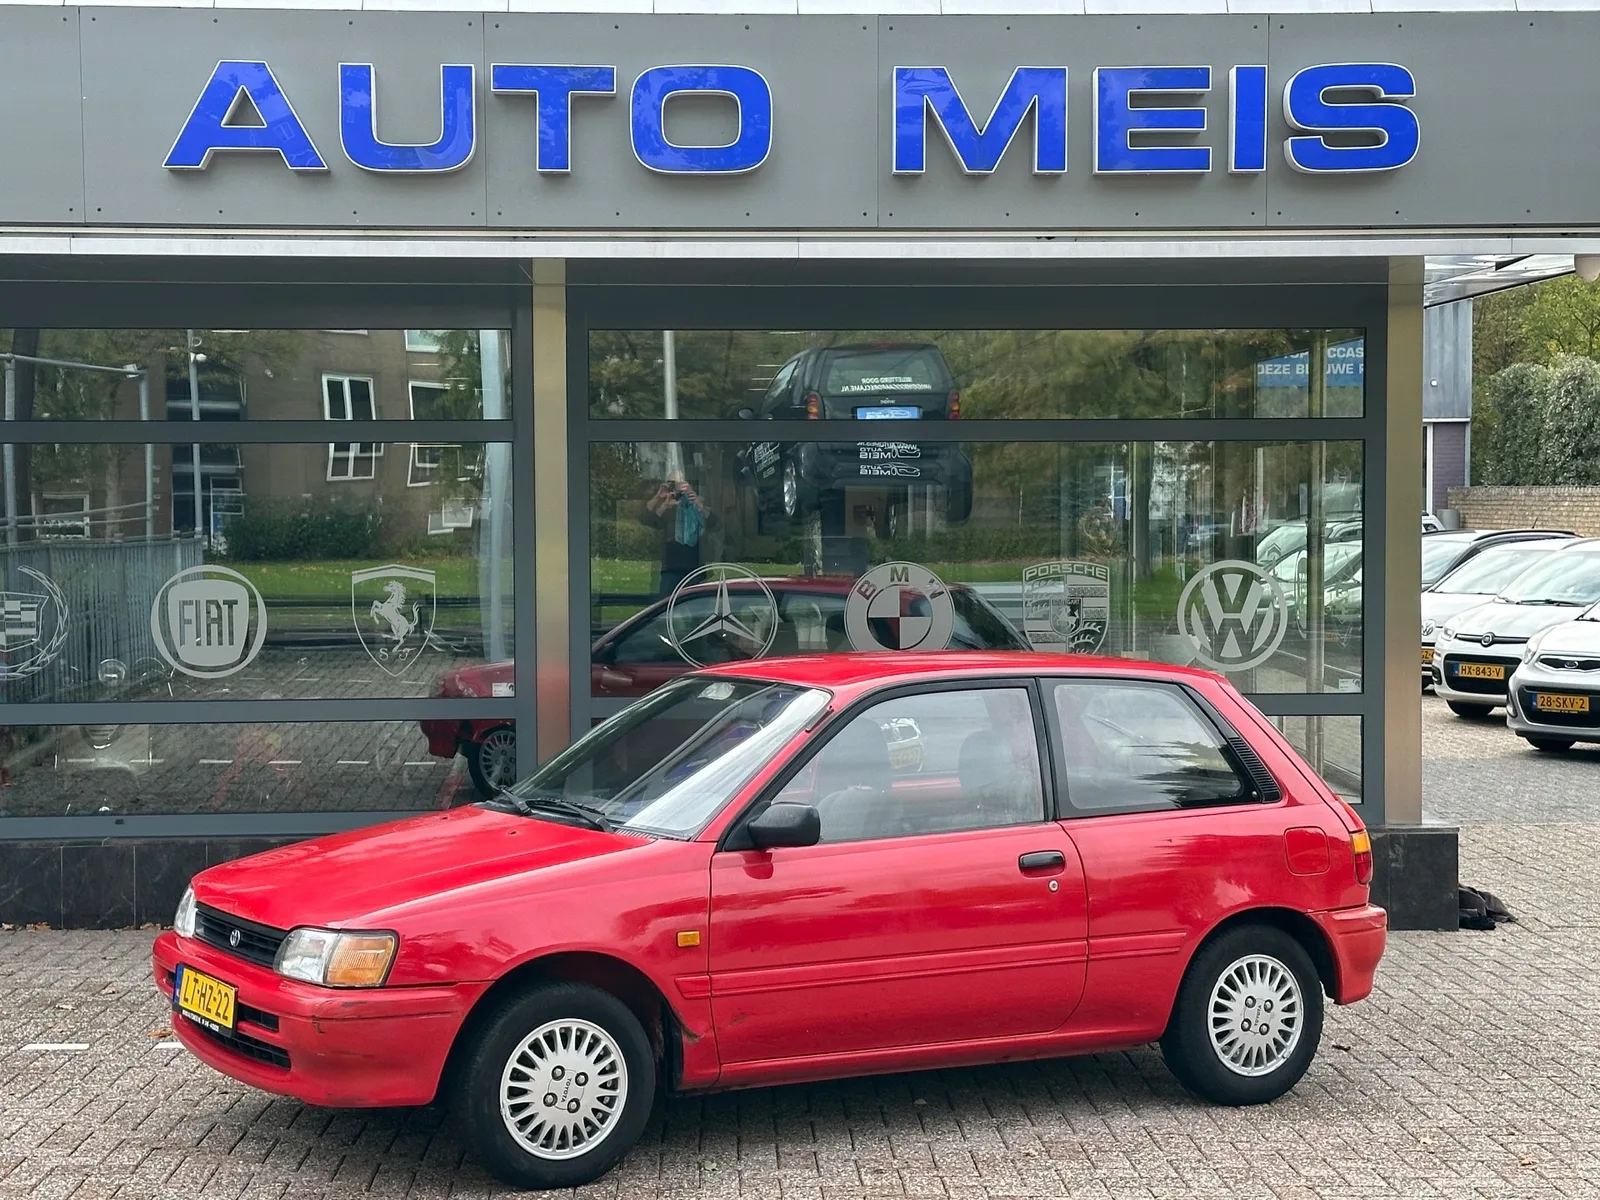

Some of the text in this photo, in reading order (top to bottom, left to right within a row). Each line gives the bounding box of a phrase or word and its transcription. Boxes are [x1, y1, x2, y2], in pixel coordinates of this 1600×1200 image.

[163, 60, 1421, 175] AUTO MEIS
[857, 566, 945, 600] BMW
[1026, 563, 1107, 581] PORSCHE
[179, 600, 238, 647] FIAT
[1461, 665, 1501, 677] HX-843-V
[1540, 695, 1586, 709] 28-SKV-2
[183, 974, 230, 1022] LT-HZ-22
[561, 1077, 573, 1103] TOYOTA
